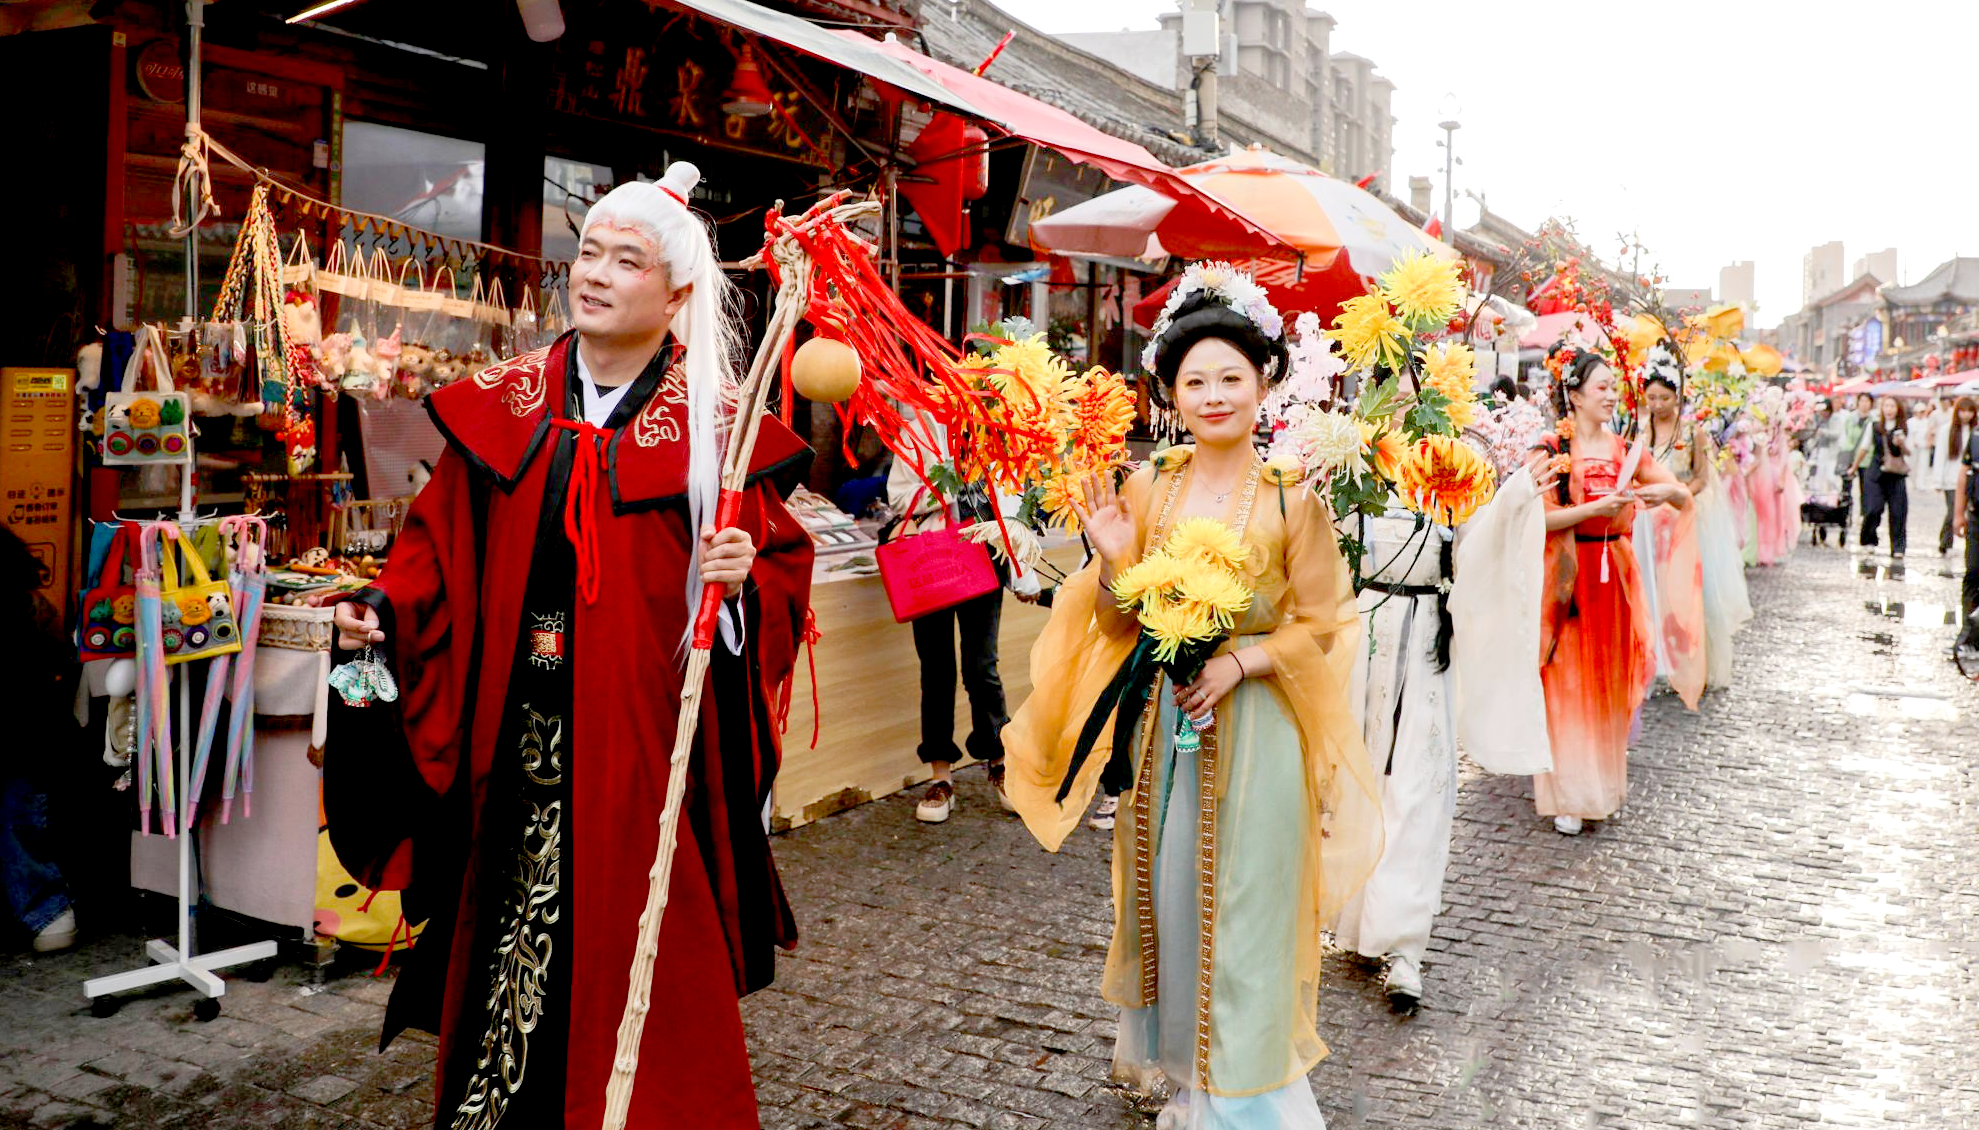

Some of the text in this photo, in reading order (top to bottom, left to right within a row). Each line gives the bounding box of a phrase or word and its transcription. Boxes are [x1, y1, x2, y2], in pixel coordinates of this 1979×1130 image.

[145, 62, 184, 80] 可口可
[246, 80, 279, 98] 这感觉
